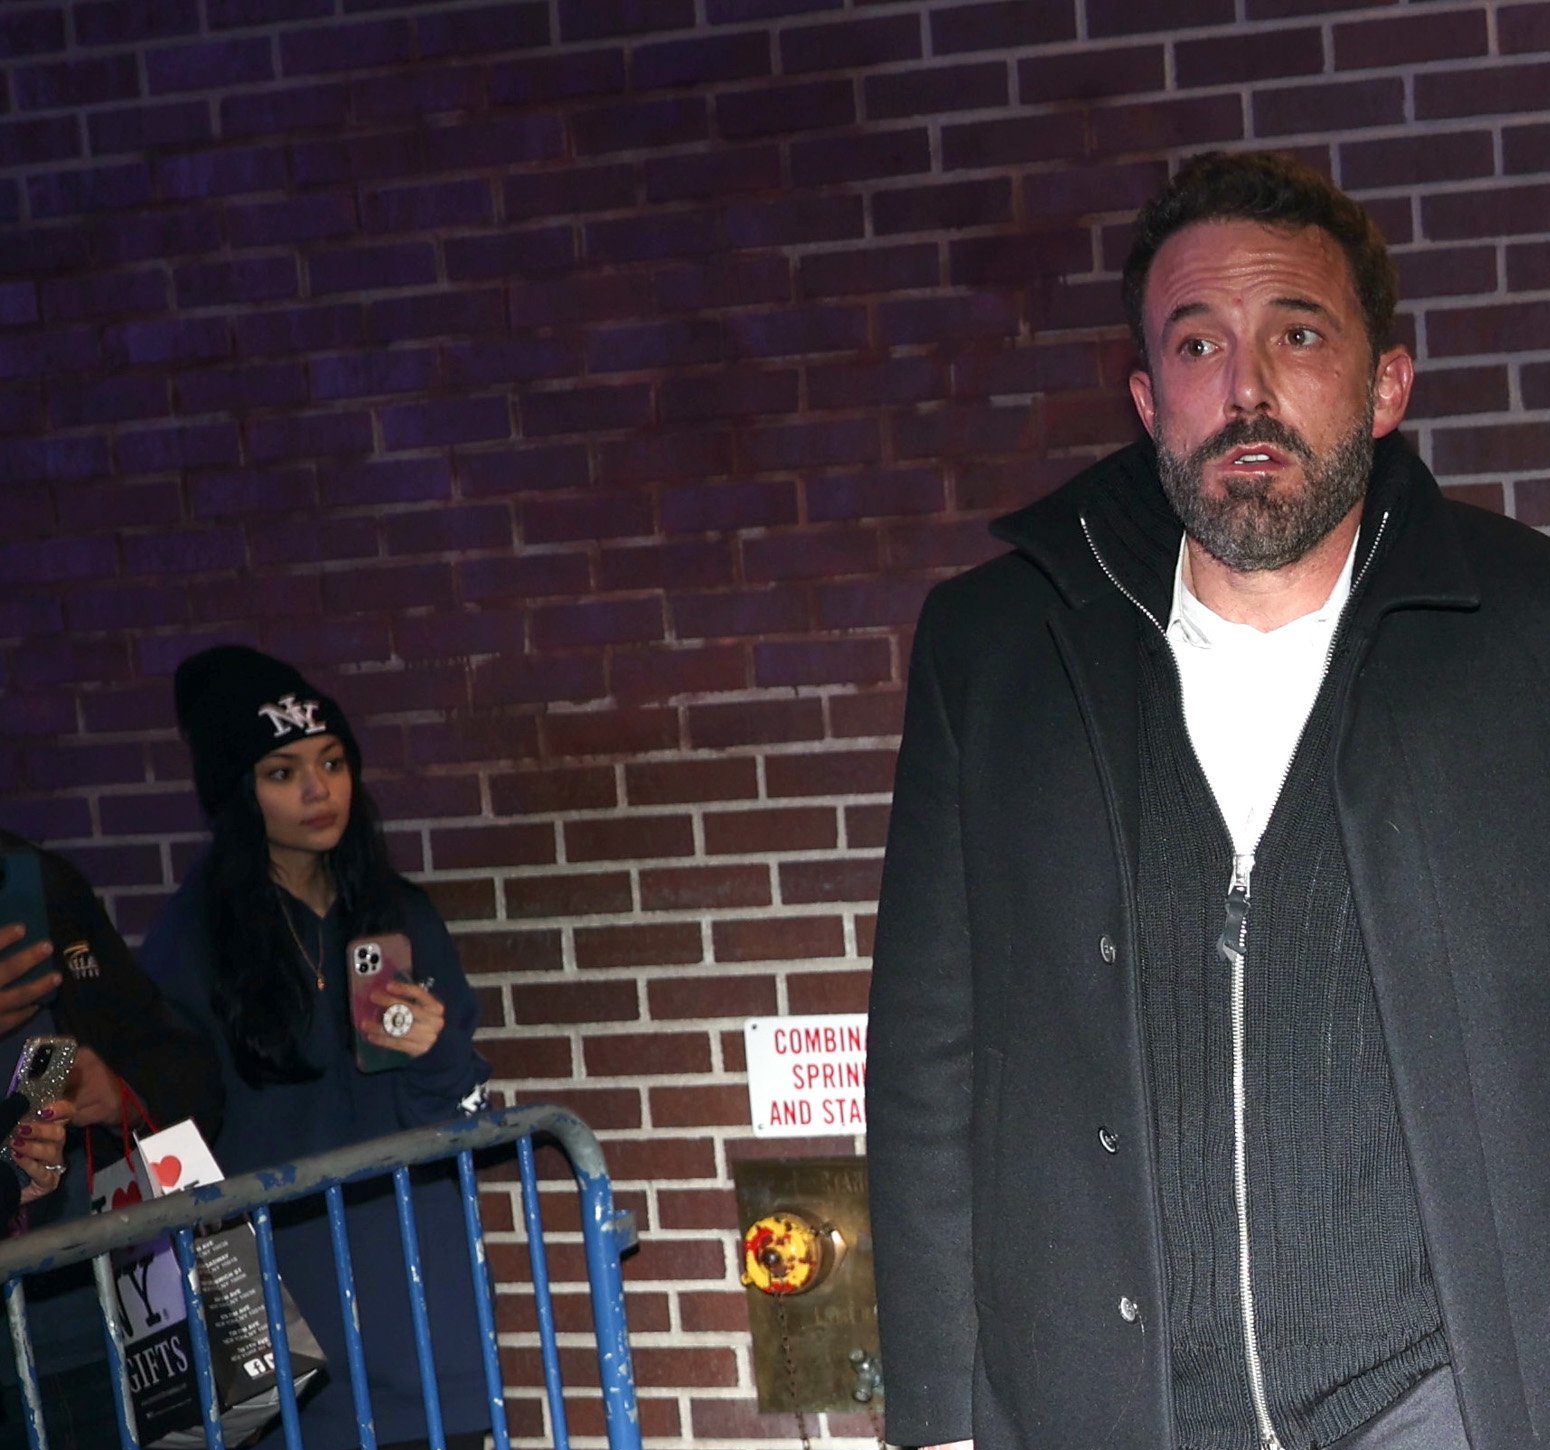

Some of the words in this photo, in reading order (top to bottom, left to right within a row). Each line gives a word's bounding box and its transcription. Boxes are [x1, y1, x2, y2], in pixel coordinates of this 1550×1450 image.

[258, 695, 327, 738] NY
[773, 1026, 867, 1056] COMBIN
[770, 1099, 812, 1126] AND
[821, 1097, 865, 1125] STA
[126, 1335, 188, 1393] GIFTS
